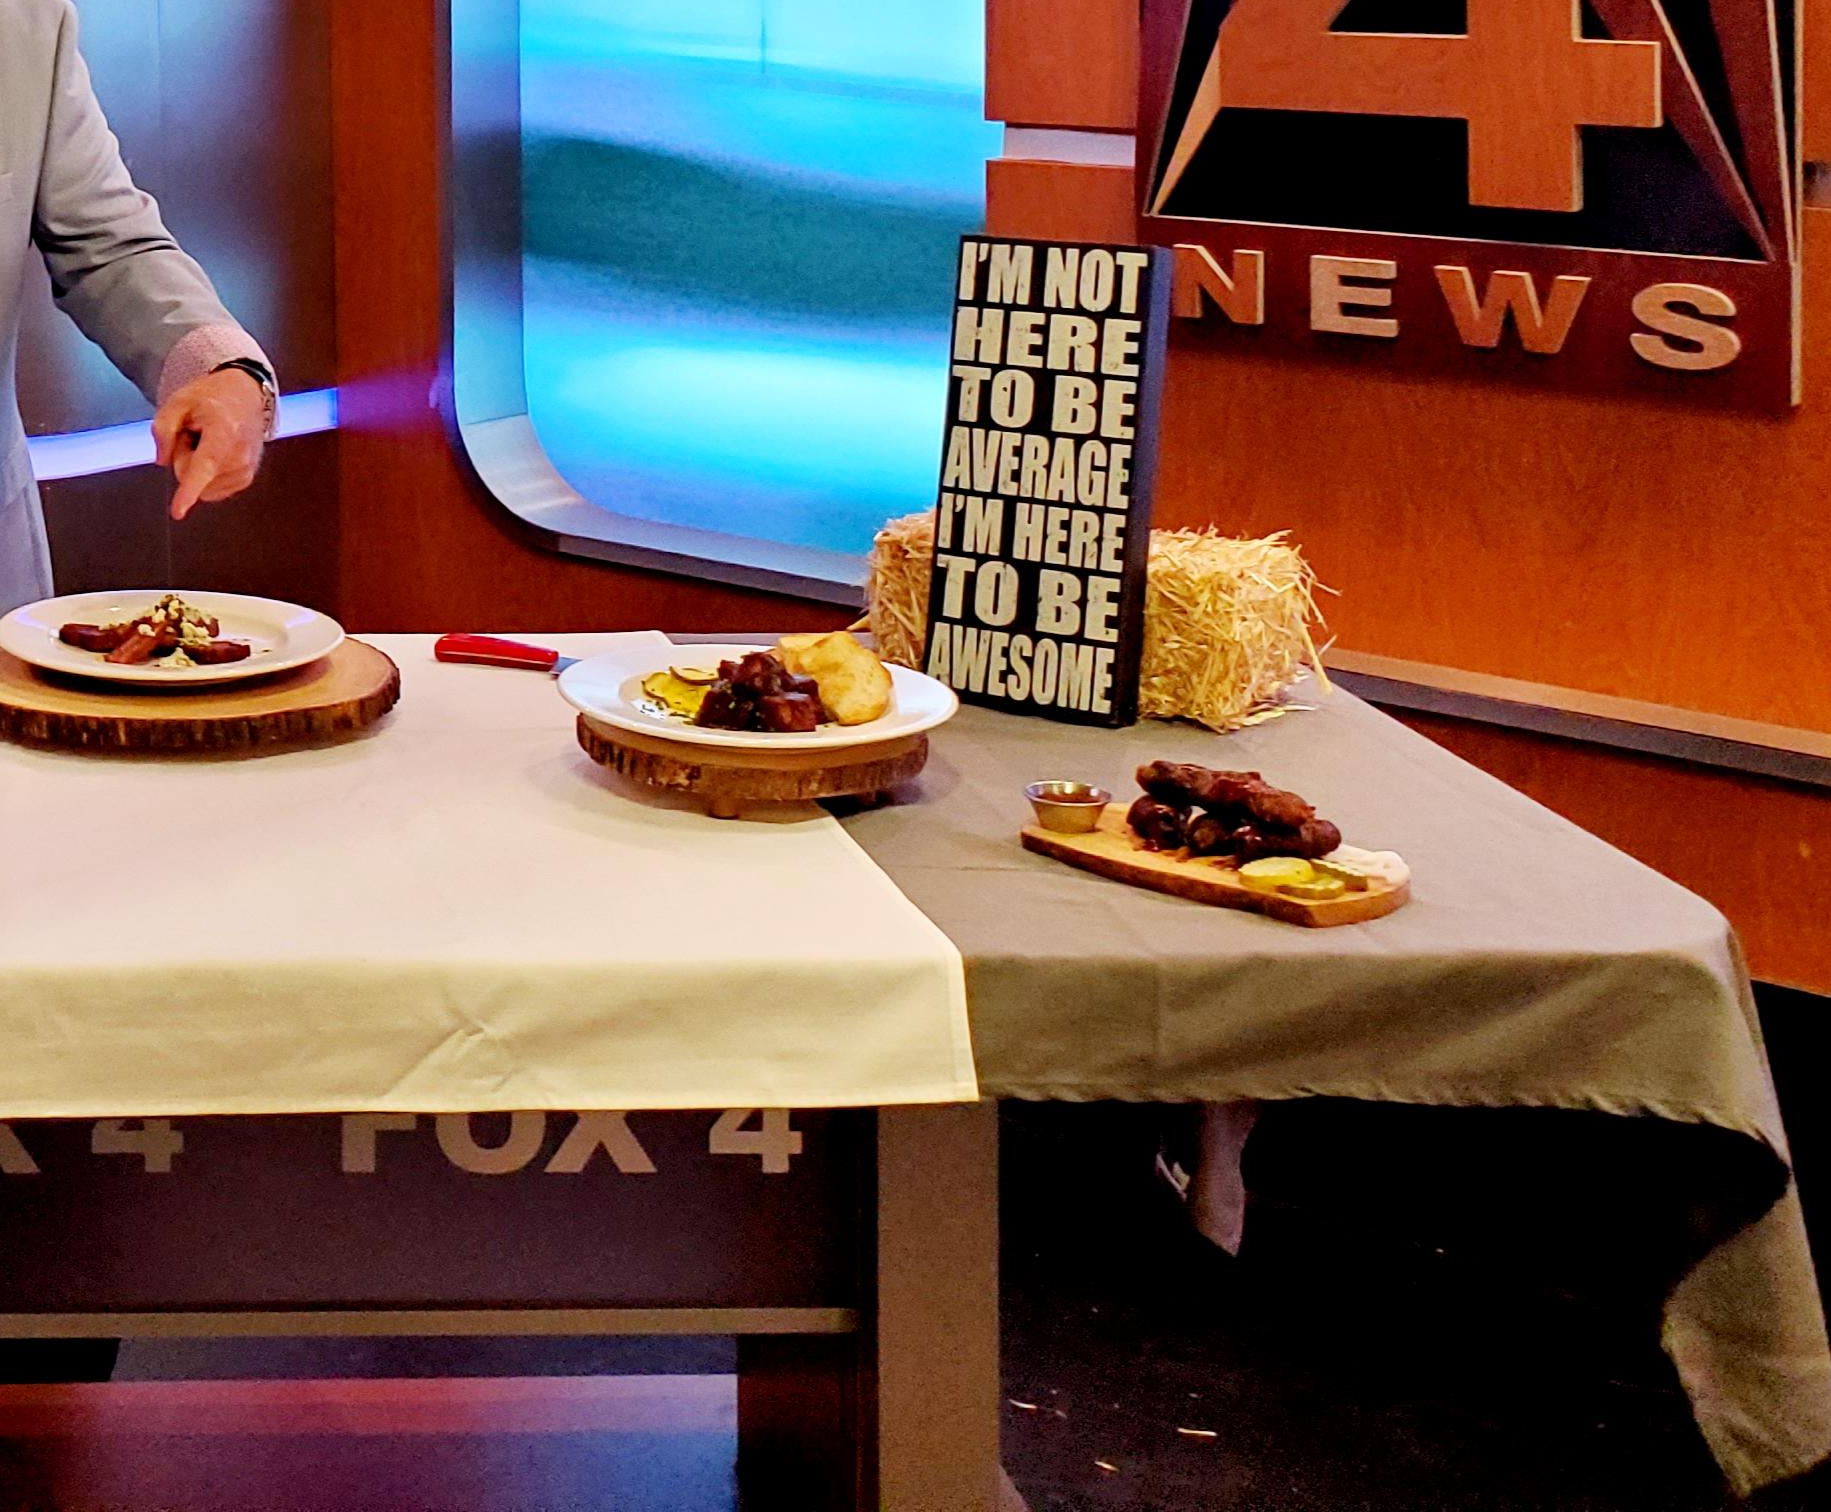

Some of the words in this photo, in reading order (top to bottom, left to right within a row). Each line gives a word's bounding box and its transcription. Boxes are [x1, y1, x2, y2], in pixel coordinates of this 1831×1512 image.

[959, 242, 1034, 305] I'M
[1043, 247, 1148, 314] NOT
[1172, 243, 1742, 370] NEWS
[953, 306, 1142, 377] HERE
[952, 364, 1035, 429] TO
[1052, 374, 1137, 440] BE
[943, 426, 1132, 510] AVERAGE
[937, 492, 1002, 557] I'M
[1012, 502, 1127, 574] HERE
[936, 553, 1019, 627] TO
[1035, 568, 1119, 644] BE
[927, 622, 1115, 715] AWESOME
